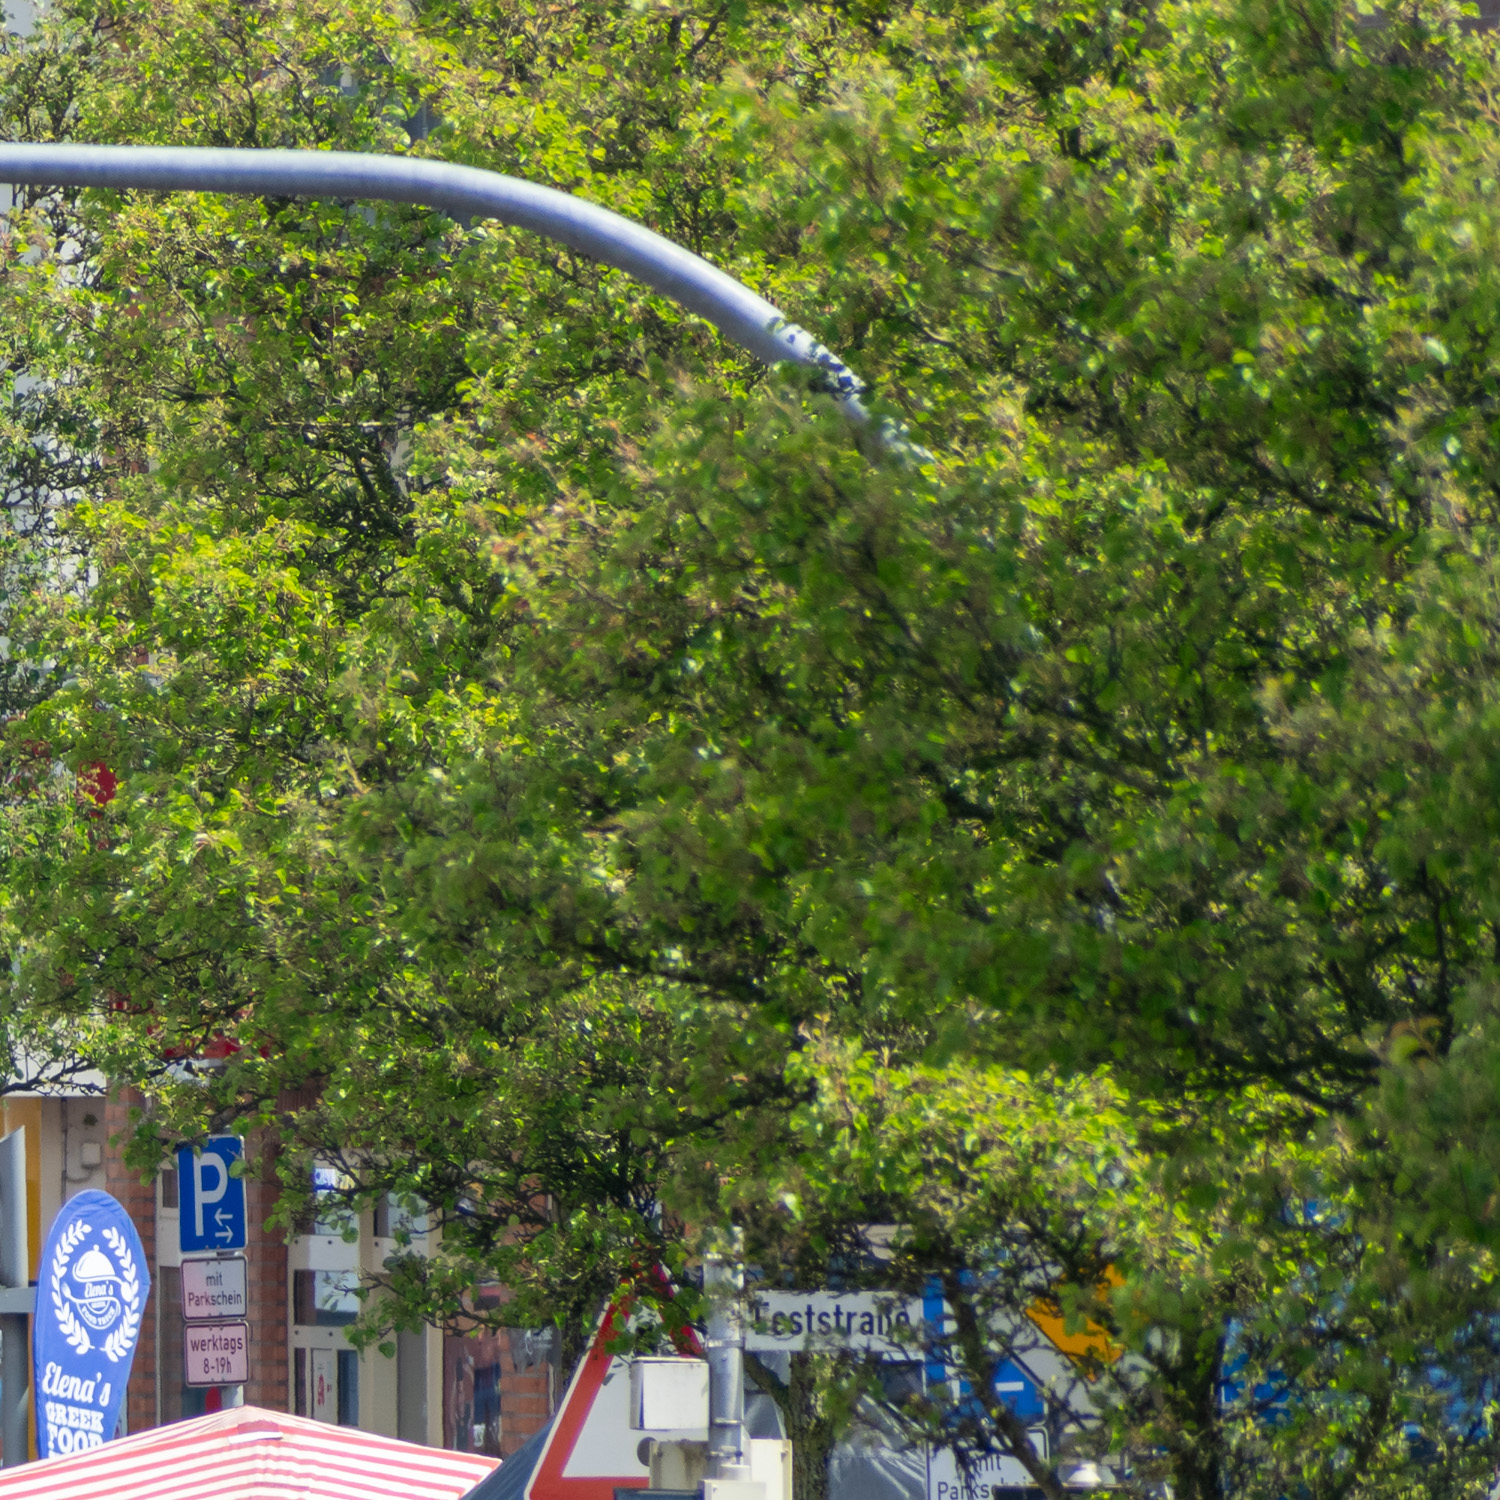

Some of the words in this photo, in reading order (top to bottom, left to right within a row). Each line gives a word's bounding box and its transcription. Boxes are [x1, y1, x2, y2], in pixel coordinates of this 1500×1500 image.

[193, 1152, 228, 1237] P
[205, 1271, 223, 1287] mit
[187, 1291, 242, 1306] Parkschein
[190, 1334, 243, 1355] werktags
[203, 1357, 232, 1374] 8-19h
[42, 1361, 112, 1407] Elena's
[45, 1401, 104, 1433] GREEK
